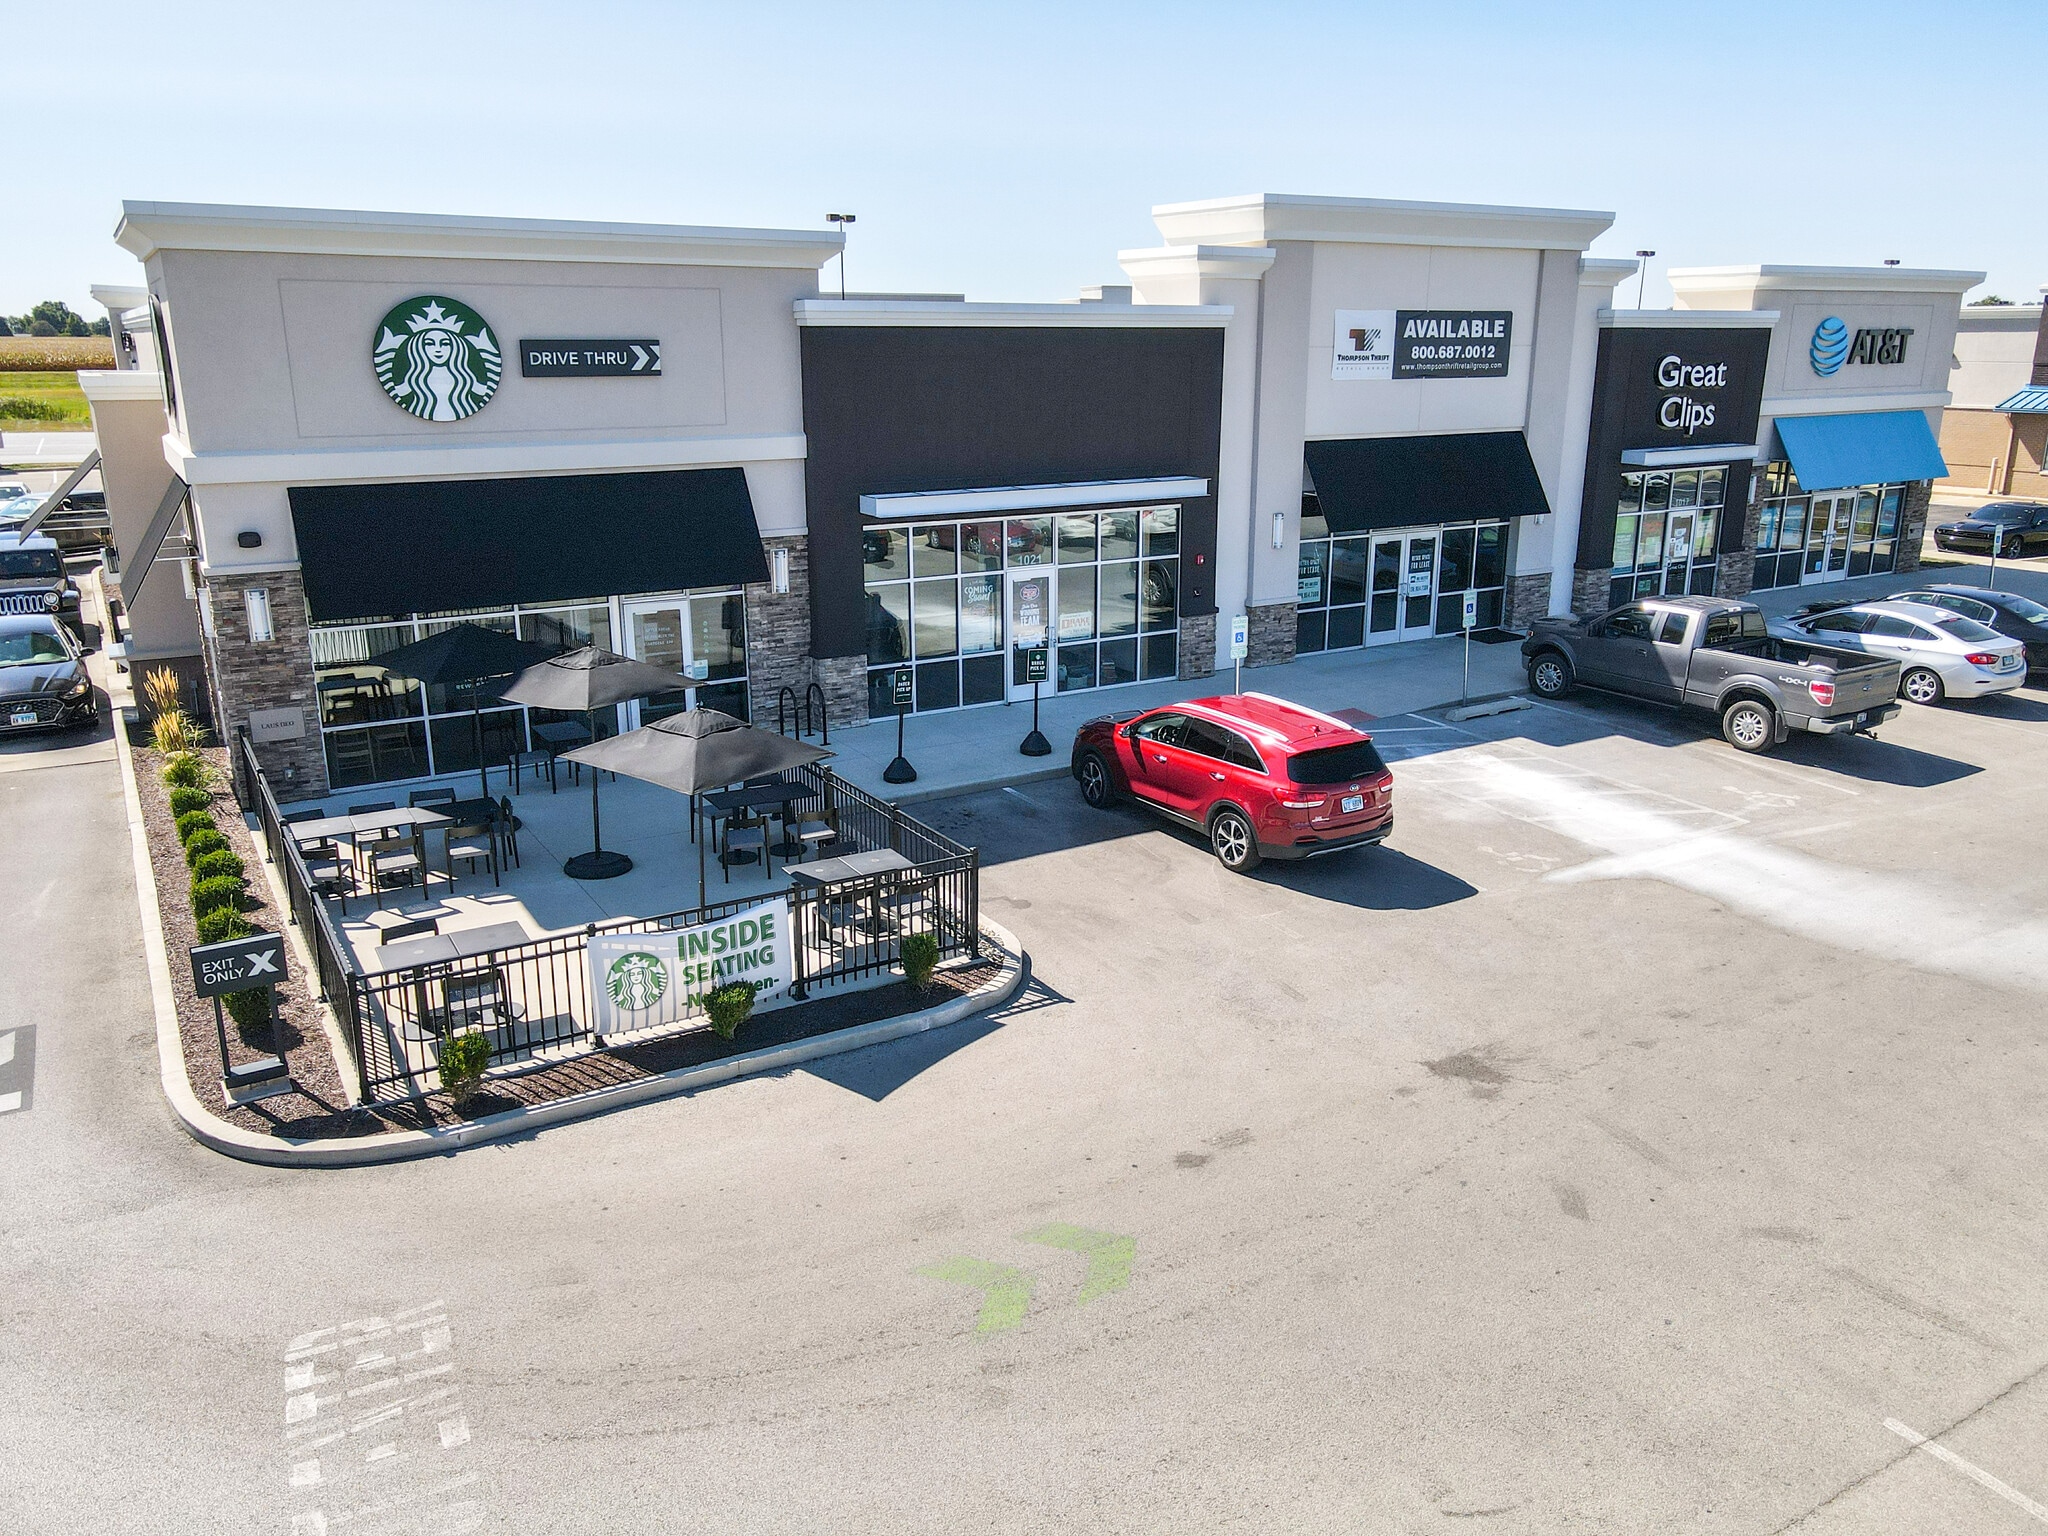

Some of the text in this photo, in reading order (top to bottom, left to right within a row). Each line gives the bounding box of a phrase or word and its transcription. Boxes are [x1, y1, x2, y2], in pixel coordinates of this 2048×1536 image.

[1403, 319, 1505, 338] AVAILABLE
[1411, 345, 1495, 359] 800.687.0012
[1846, 328, 1914, 365] AT&T
[529, 351, 628, 366] DRIVE THRU
[1657, 355, 1728, 388] Great
[1660, 396, 1716, 435] Clips
[1017, 554, 1042, 566] 1021
[964, 585, 994, 594] COMING
[1020, 615, 1040, 626] TEAM
[677, 913, 776, 962] INSIDE
[202, 957, 235, 973] EXIT
[682, 944, 775, 986] SEATING
[204, 967, 244, 984] ONLY
